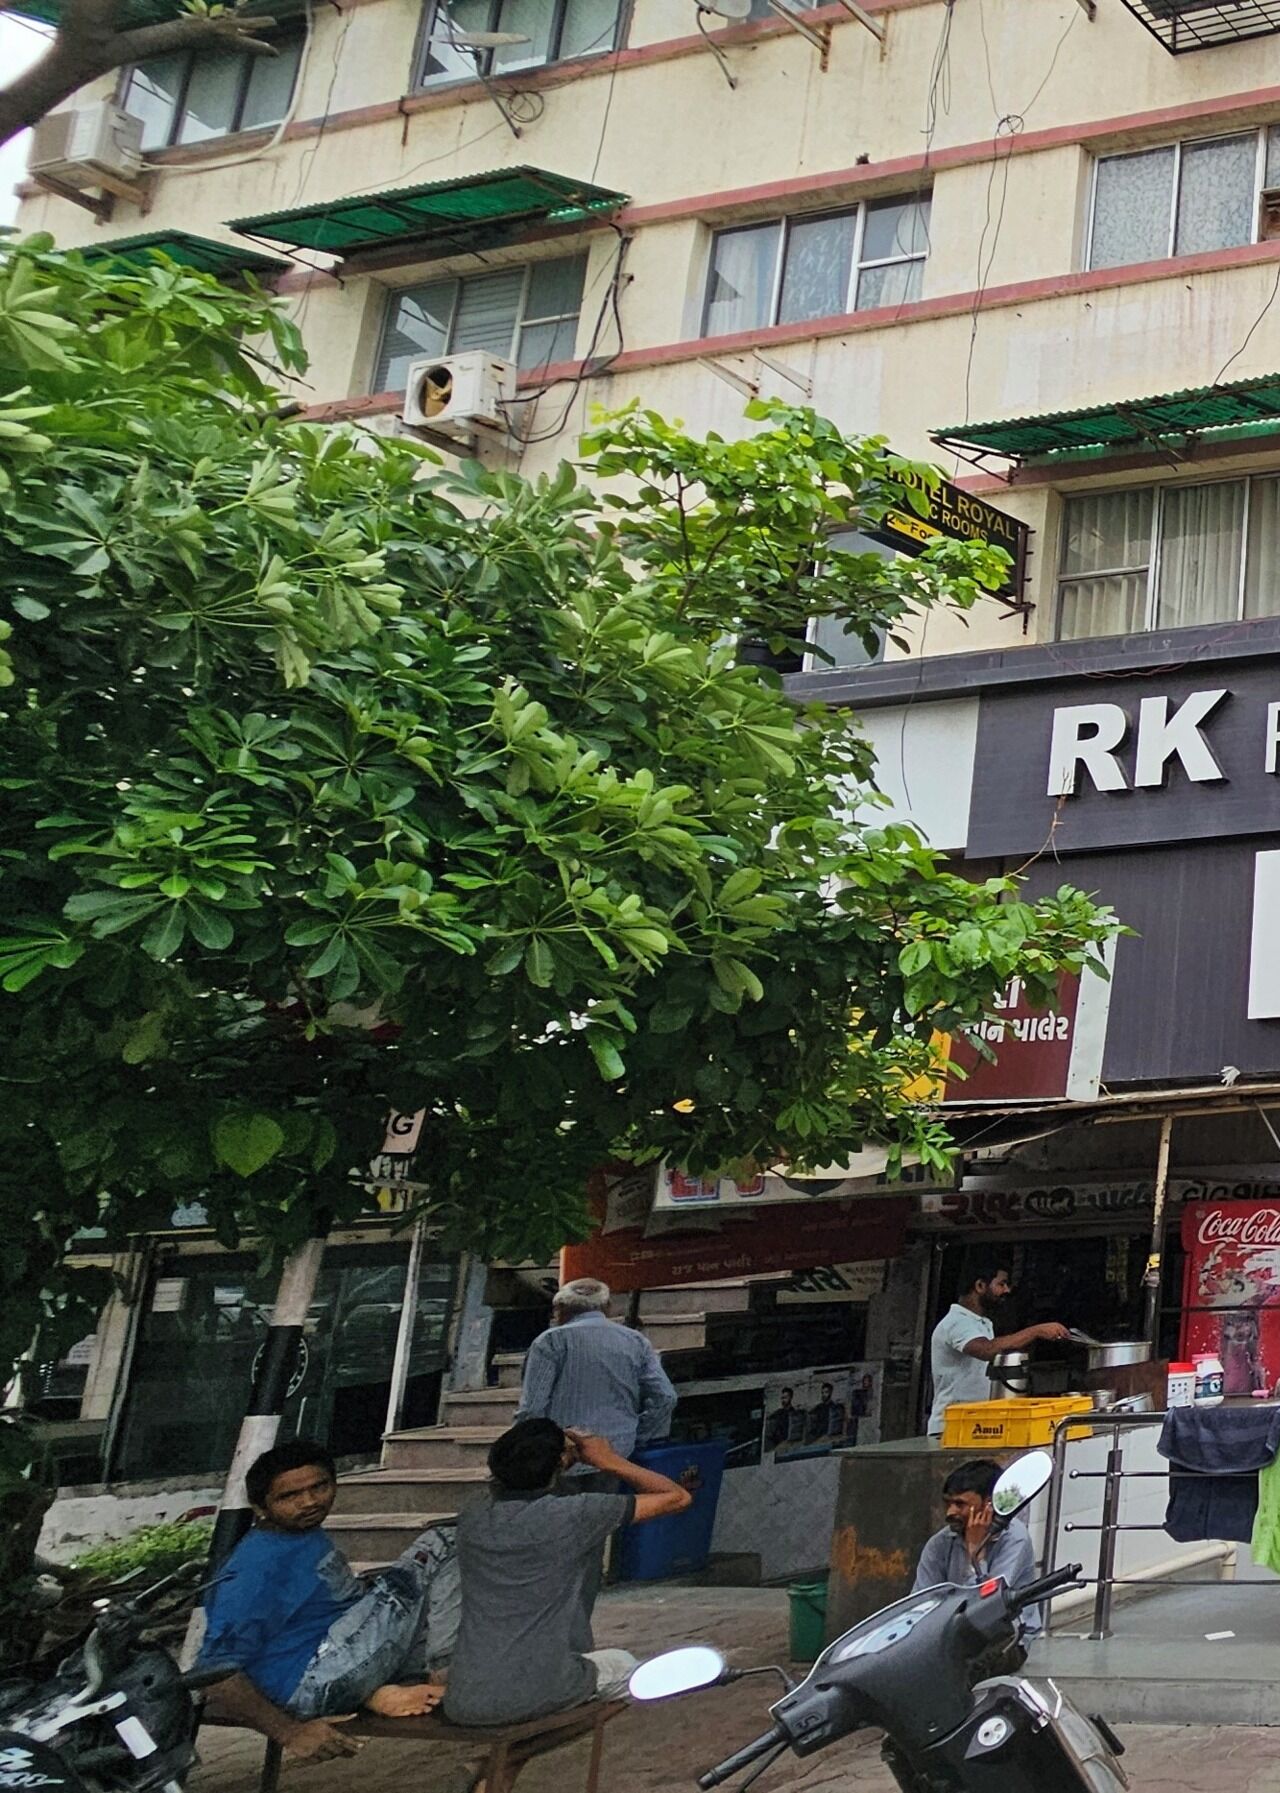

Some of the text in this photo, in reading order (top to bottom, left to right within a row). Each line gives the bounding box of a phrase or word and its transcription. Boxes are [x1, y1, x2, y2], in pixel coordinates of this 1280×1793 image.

[941, 510, 989, 544] ROOMS
[957, 495, 1015, 542] ROYAL
[1047, 688, 1230, 797] RK
[972, 1423, 1004, 1435] Amul
